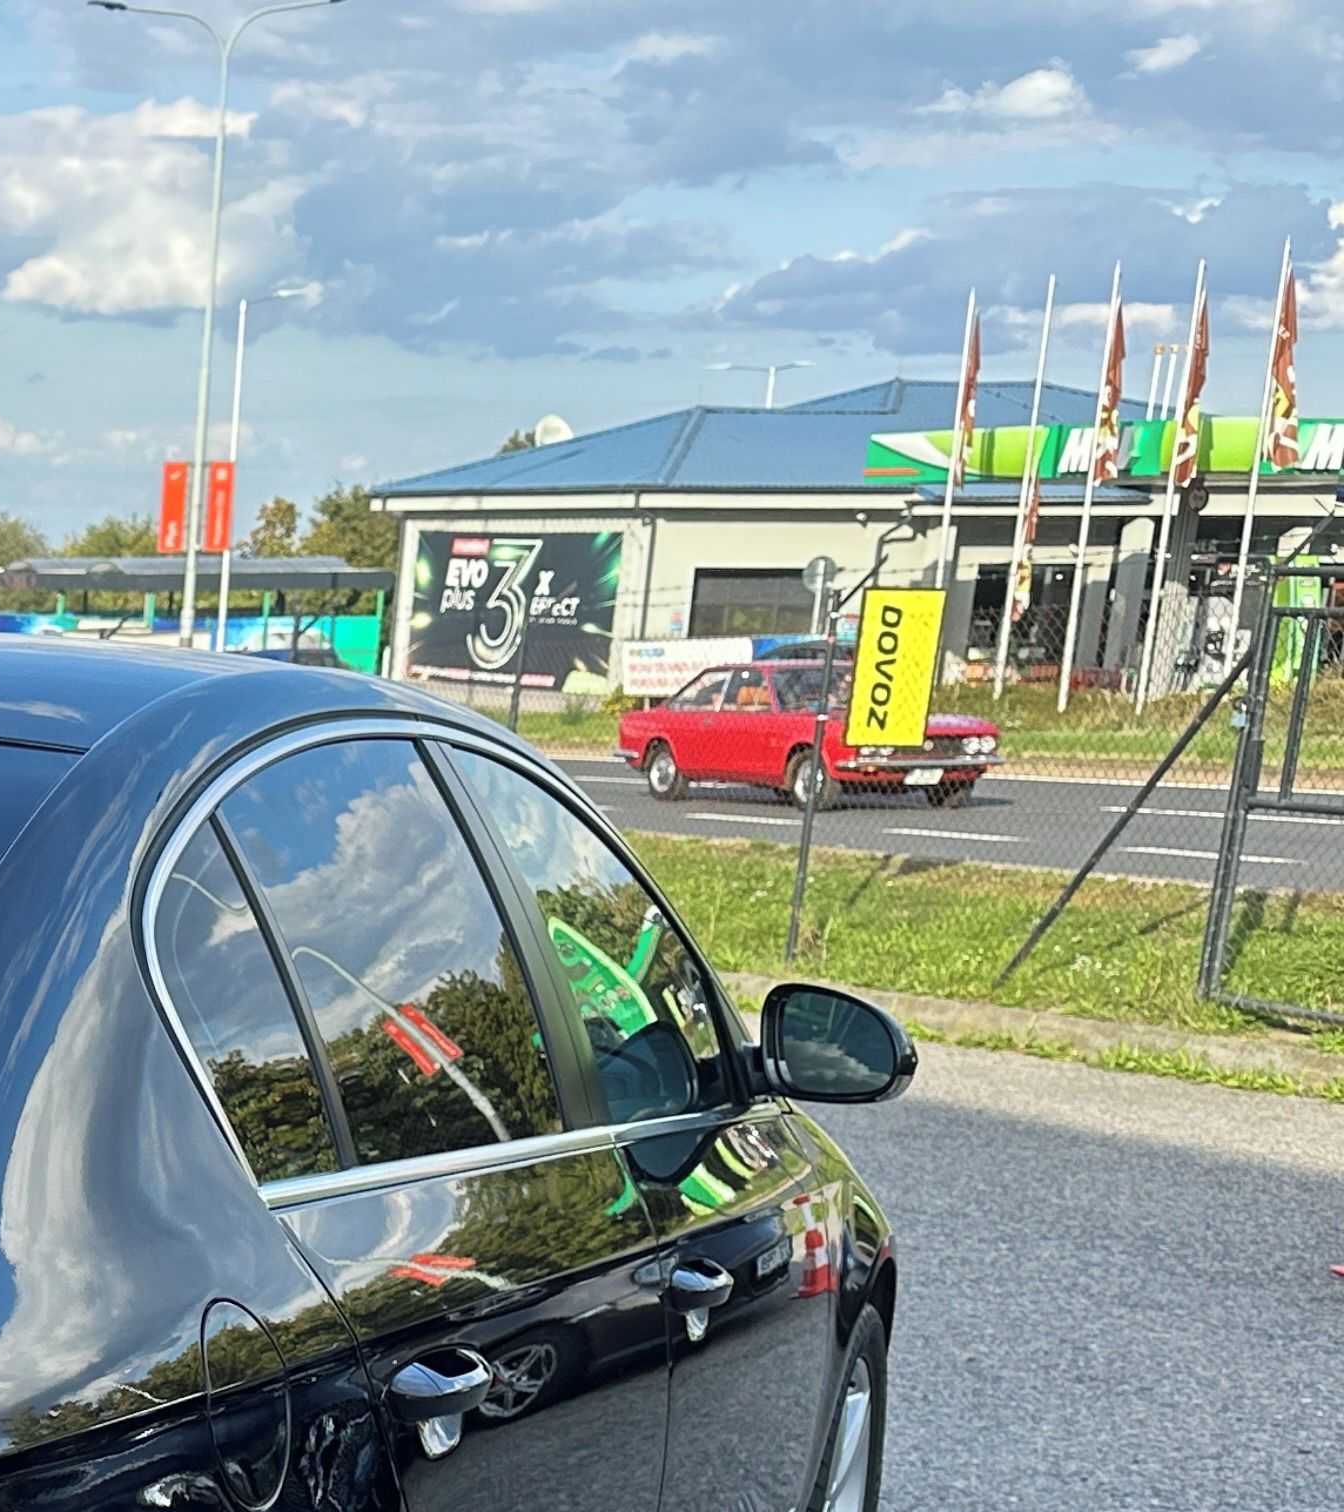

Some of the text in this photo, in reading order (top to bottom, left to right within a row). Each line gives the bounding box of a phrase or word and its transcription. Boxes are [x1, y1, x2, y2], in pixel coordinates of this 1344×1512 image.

[445, 558, 489, 588] EVO
[440, 588, 476, 613] plus
[866, 604, 903, 732] DOVOZ
